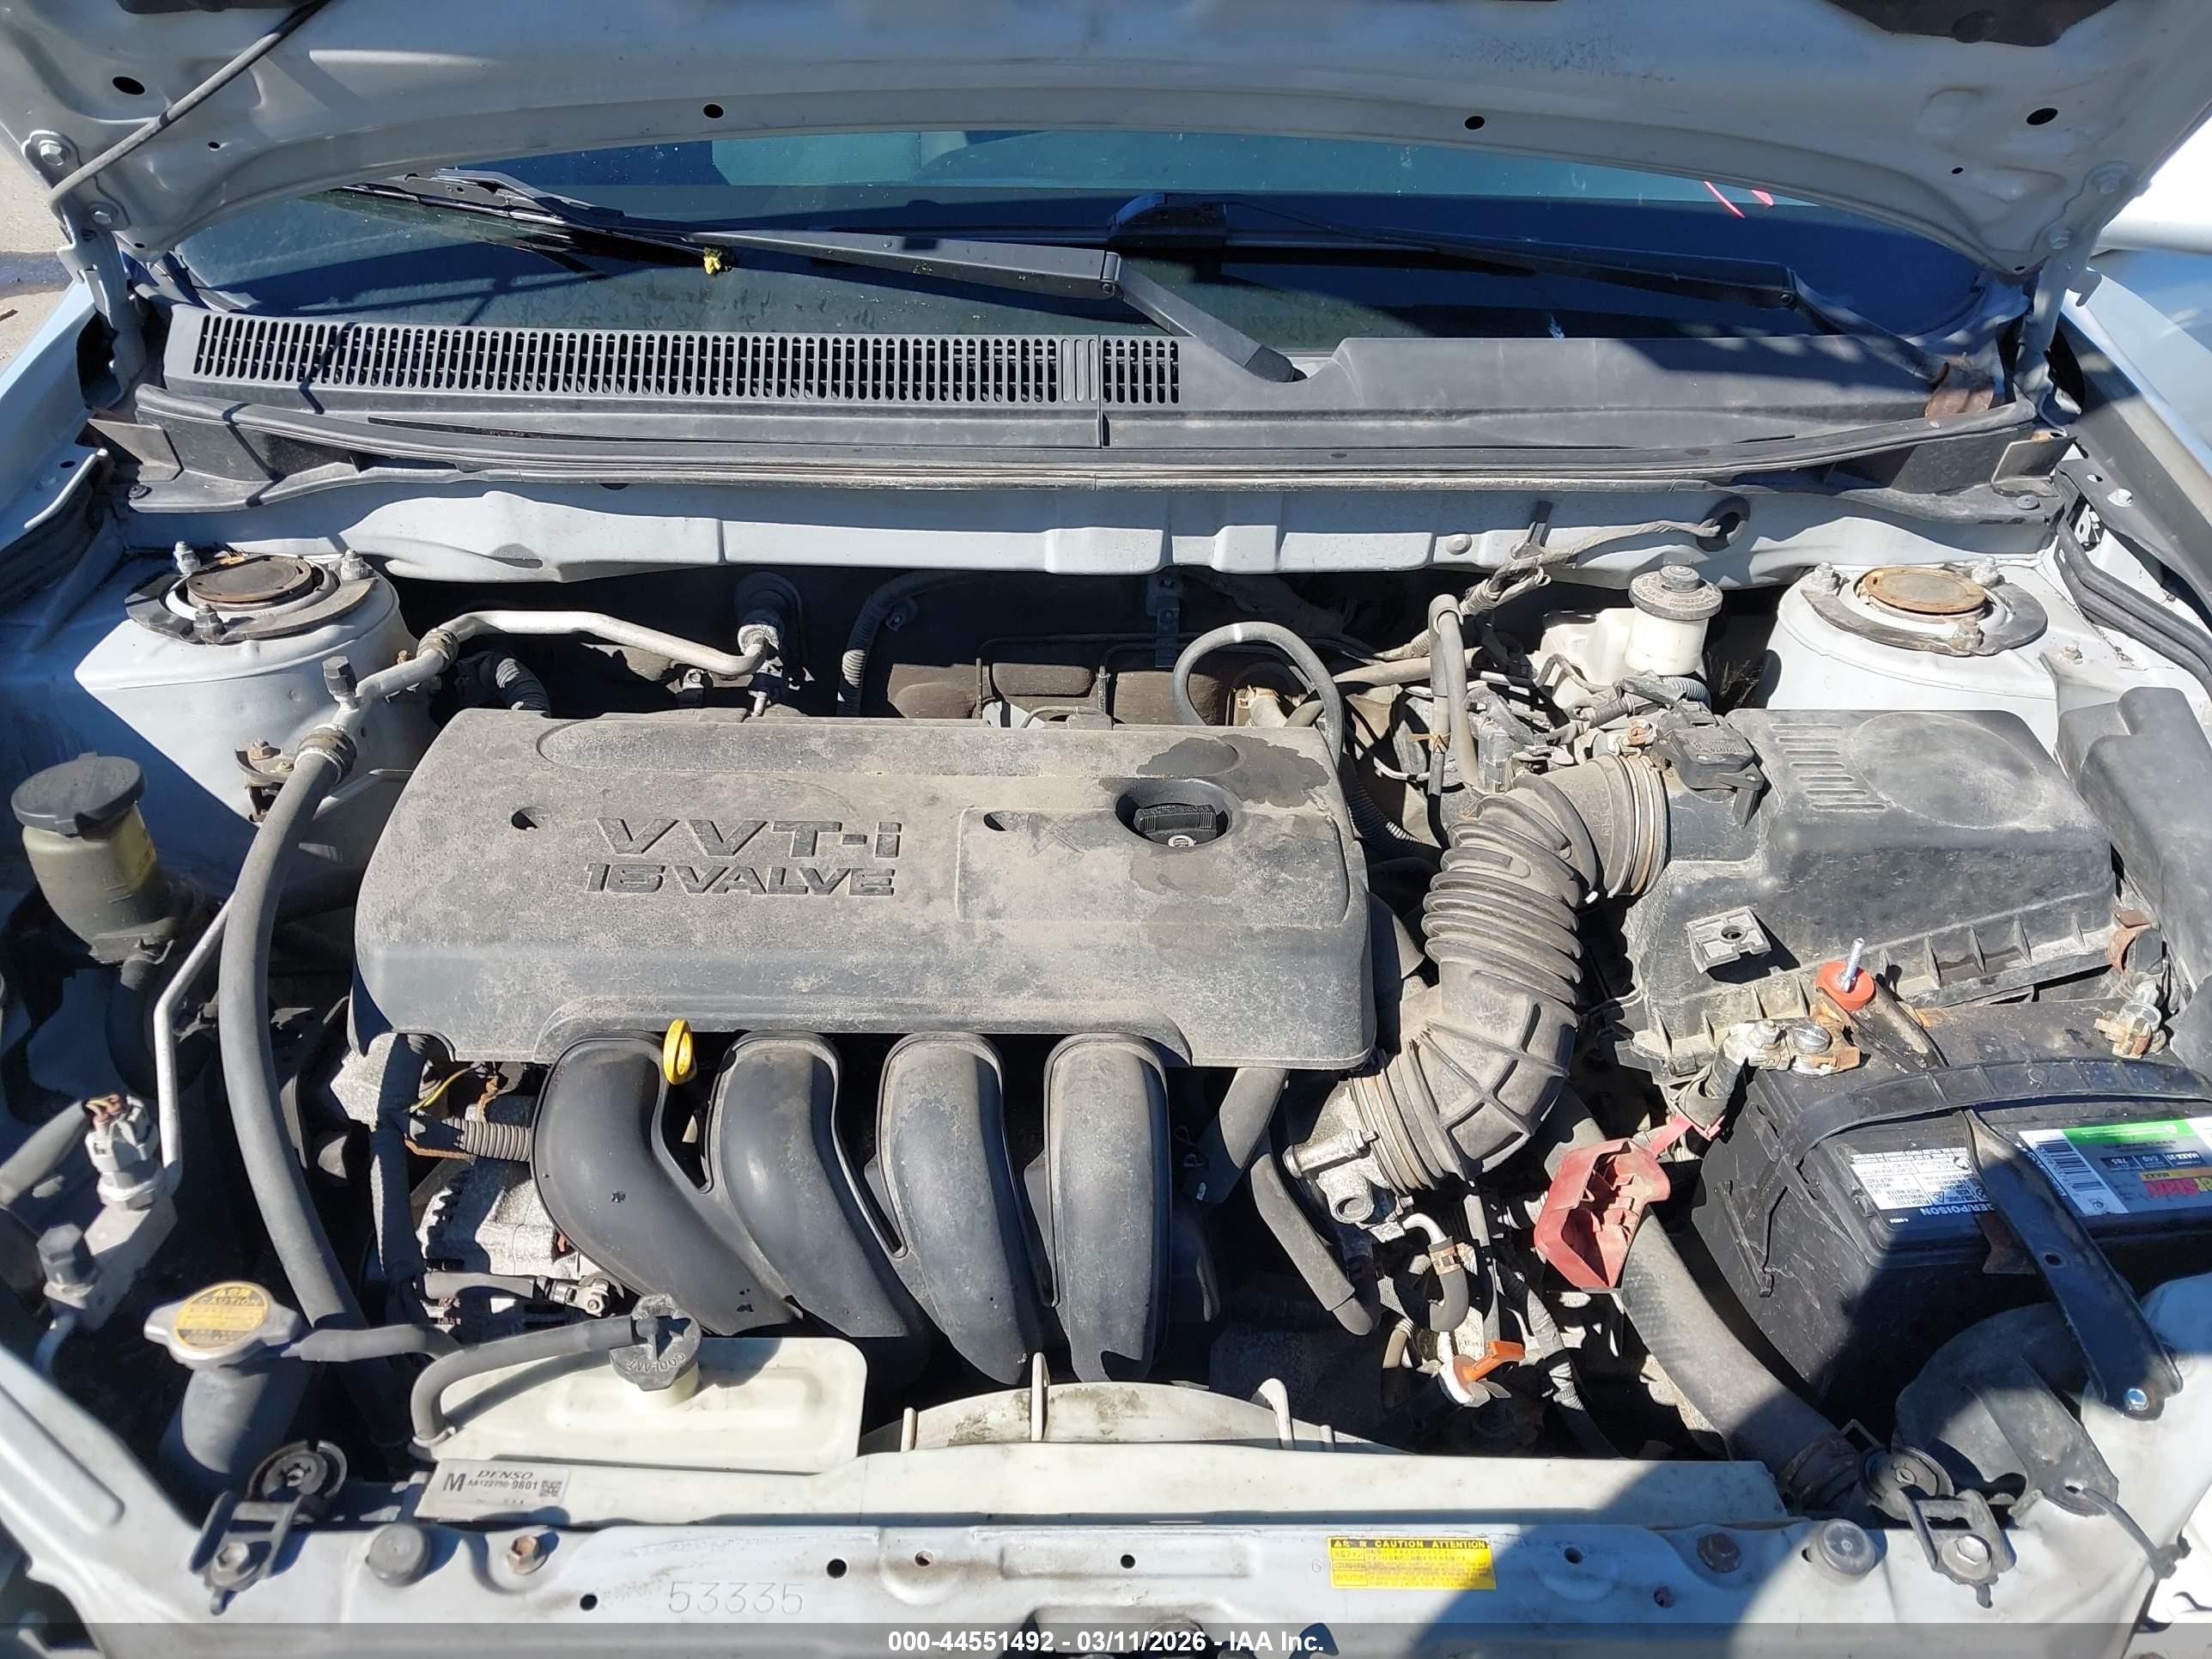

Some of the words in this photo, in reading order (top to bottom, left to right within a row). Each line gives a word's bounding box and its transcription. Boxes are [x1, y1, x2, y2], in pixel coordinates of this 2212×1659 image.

[477, 1469, 534, 1480] DENSO
[1375, 1539, 1424, 1548] CAUTION
[1431, 1539, 1486, 1548] ATTENTION
[668, 1581, 805, 1615] 53335
